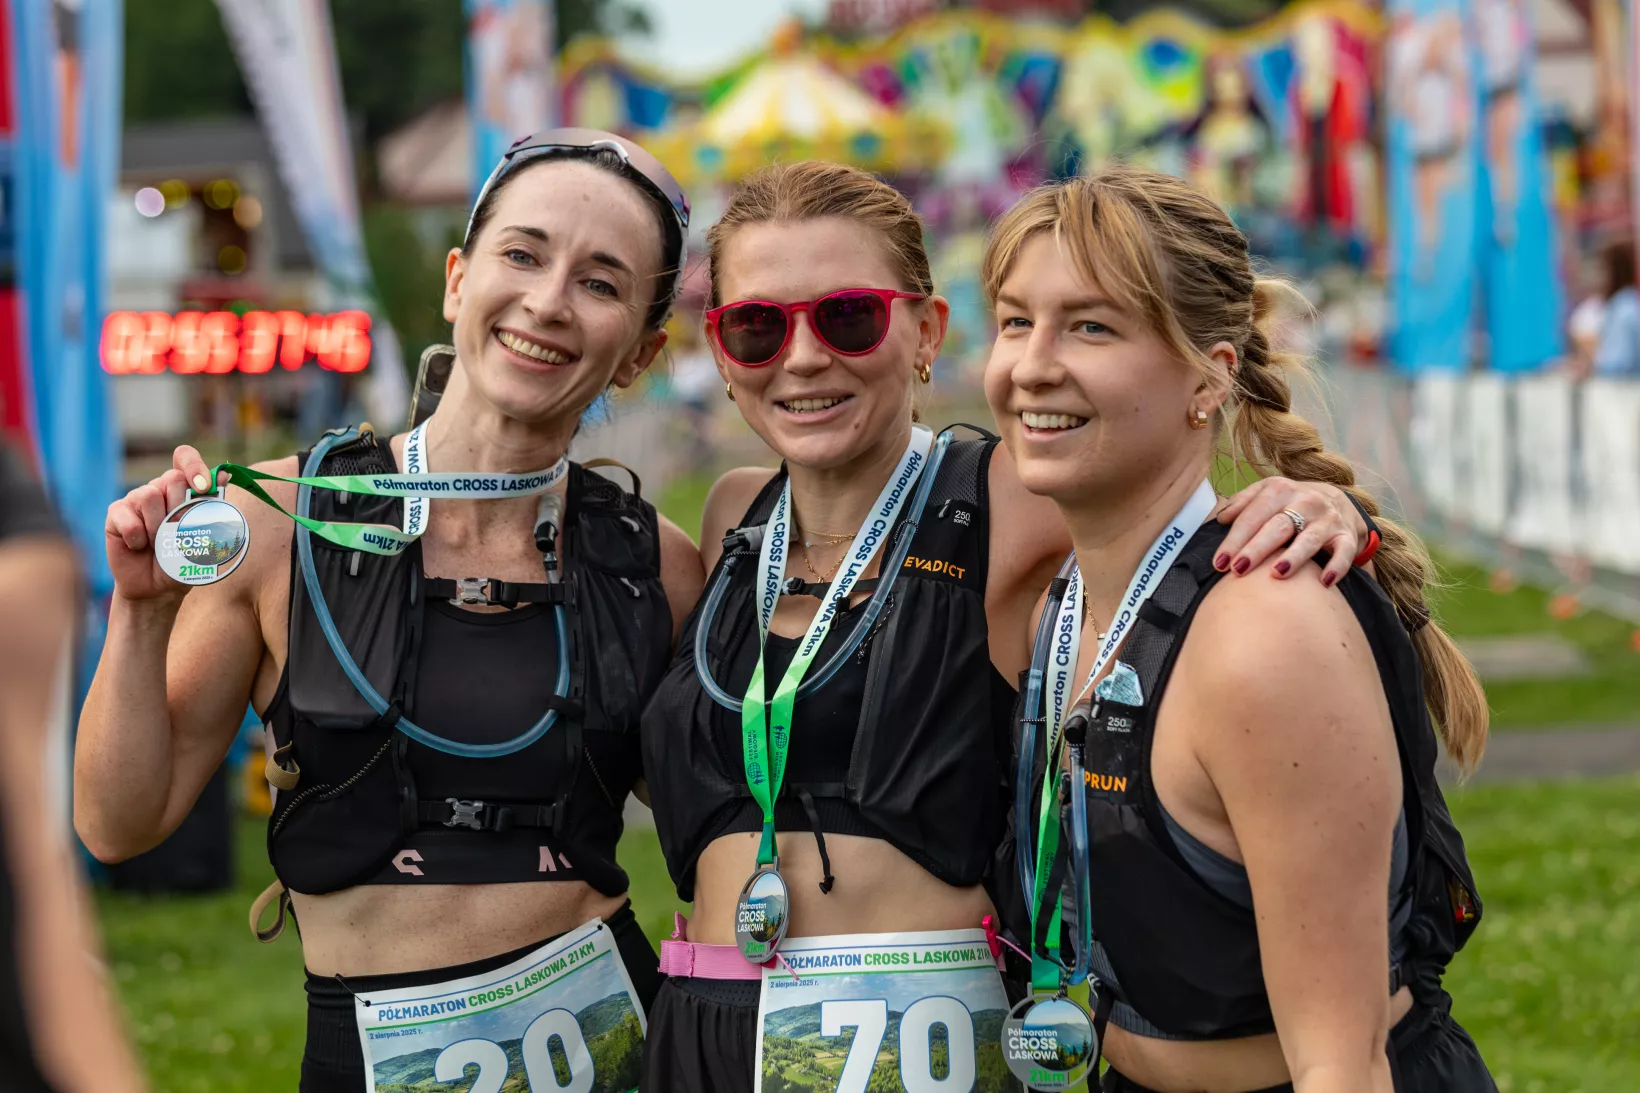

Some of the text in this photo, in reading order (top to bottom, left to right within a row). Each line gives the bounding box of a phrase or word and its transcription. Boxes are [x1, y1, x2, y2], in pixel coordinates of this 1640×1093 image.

[373, 478, 449, 491] Półmaraton
[453, 478, 498, 491] CROSS
[501, 471, 554, 491] LASKOWA
[408, 443, 422, 504] LOWA
[407, 504, 422, 535] CROSS
[954, 510, 971, 522] 250
[162, 536, 210, 549] CROSS
[363, 533, 396, 551] 21km
[769, 522, 786, 563] CROSS
[161, 547, 210, 558] LASKOWA
[801, 450, 923, 657] Półmaraton CROSS LASKOWA 21km
[178, 565, 215, 577] 21km
[903, 556, 966, 580] EVADICT
[1127, 526, 1185, 607] Półmaraton
[762, 564, 781, 630] LASKOWA
[1064, 567, 1079, 611] LASK
[1056, 613, 1074, 667] CROSS
[1101, 609, 1131, 660] CROSS
[1107, 716, 1127, 728] 250
[738, 910, 765, 923] CROSS
[737, 923, 764, 932] LASKOWA
[745, 941, 765, 954] 21km
[782, 953, 862, 970] PÓŁMARATON
[864, 951, 910, 966] CROSS
[913, 948, 976, 965] LASKOWA
[378, 997, 467, 1022] PÓŁMARATON
[468, 985, 514, 1008] CROSS
[515, 960, 568, 993] LASKOWA
[775, 979, 798, 989] sierpnia
[799, 979, 814, 987] 2025
[375, 1030, 400, 1039] sierpnia
[400, 1028, 417, 1036] 2025
[1008, 1027, 1058, 1037] Półmaraton
[433, 1007, 596, 1093] 20
[819, 995, 978, 1093] 70
[1008, 1037, 1058, 1050] CROSS
[1009, 1050, 1059, 1060] LASKOWA
[1028, 1067, 1065, 1082] 21km
